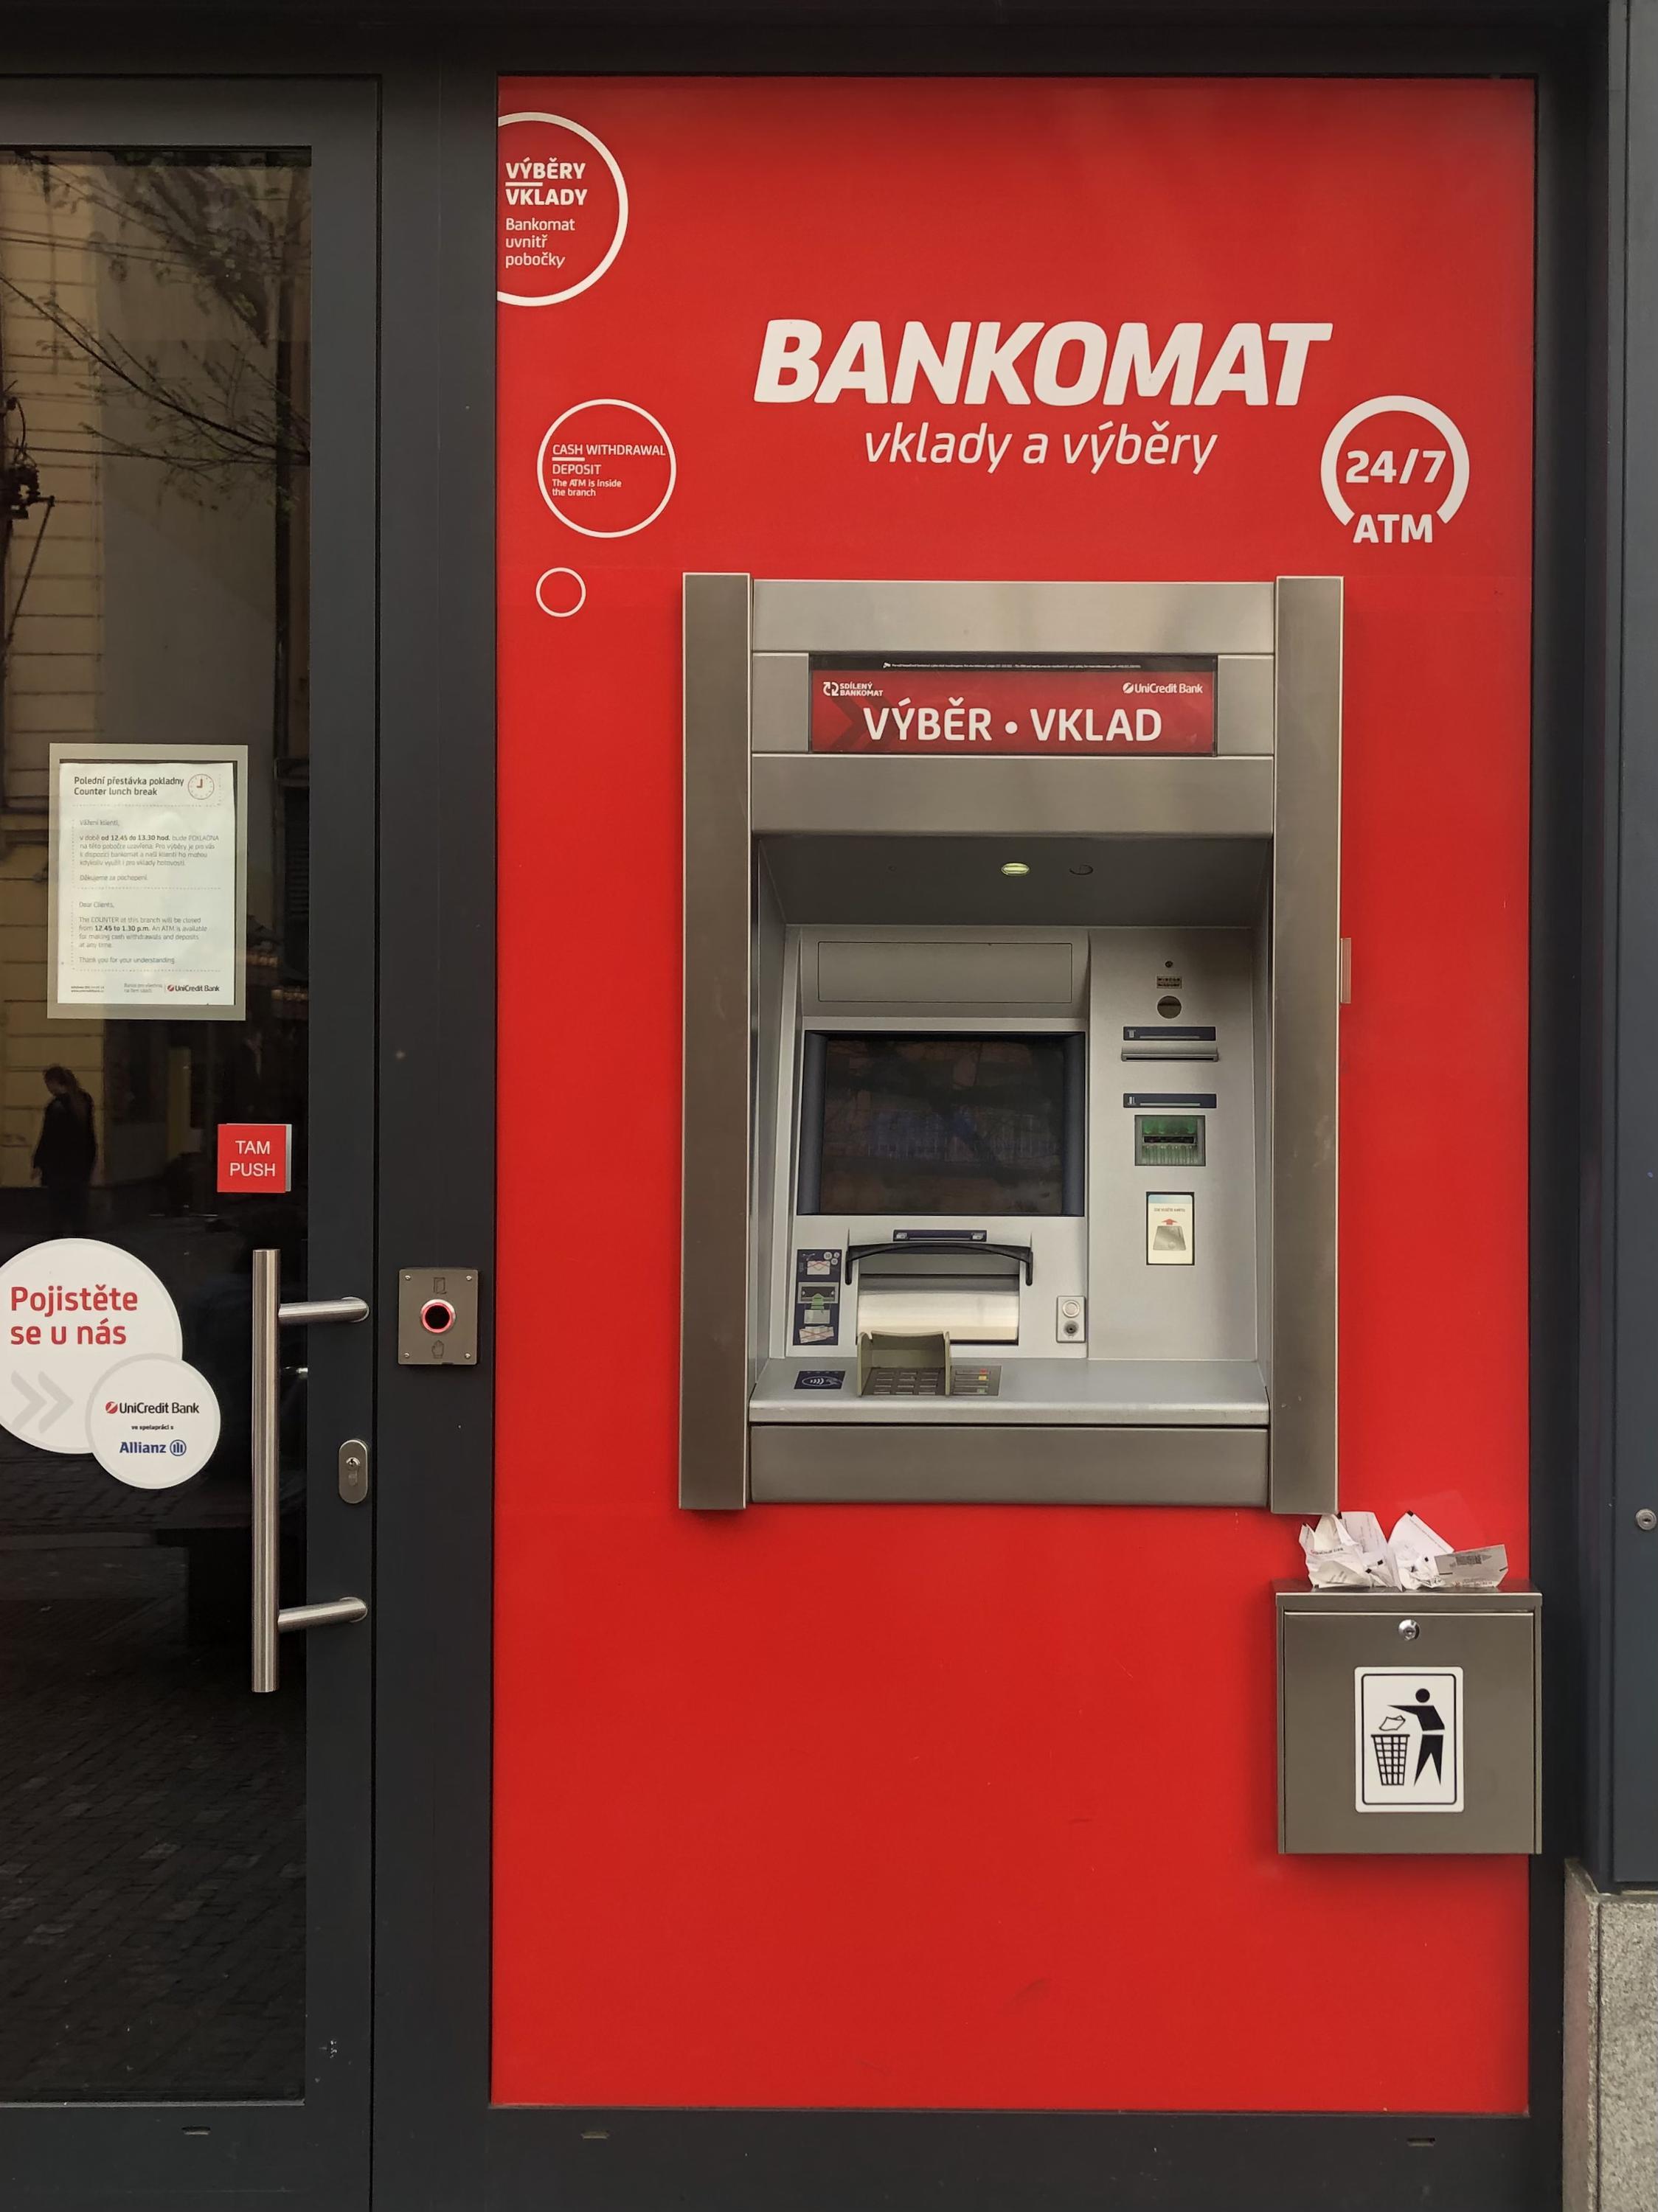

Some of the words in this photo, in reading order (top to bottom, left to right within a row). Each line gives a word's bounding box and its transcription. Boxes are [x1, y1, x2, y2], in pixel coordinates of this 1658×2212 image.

[505, 156, 586, 180] VÝBĚRY
[505, 188, 588, 206] VKLADY
[505, 218, 575, 231] Bankomat
[505, 234, 548, 248] uvnitř
[505, 251, 566, 268] pobočky
[752, 318, 1333, 407] BANKOMAT
[552, 444, 583, 455] CASH
[586, 444, 666, 456] WITHDRAWAL
[864, 421, 1013, 475] vklady
[1023, 432, 1047, 465] a
[1064, 420, 1218, 475] výběry
[552, 464, 602, 475] DEPOSIT
[1345, 448, 1446, 484] 24/7
[552, 479, 567, 487] The
[569, 479, 586, 487] ATM
[588, 479, 595, 487] is
[597, 479, 622, 487] inside
[552, 488, 566, 496] the
[567, 488, 596, 496] branch
[1353, 513, 1434, 543] ATM
[1134, 683, 1177, 693] UniCredit
[1179, 683, 1203, 693] Bank
[863, 697, 993, 741] VÝBĚR
[1030, 709, 1162, 742] VKLAD
[74, 776, 105, 785] Polední
[107, 776, 147, 786] přestávka
[149, 777, 184, 786] pokladny
[74, 787, 106, 796] Counter
[109, 787, 131, 796] lunch
[134, 787, 158, 796] break
[235, 1141, 271, 1155] TAM
[229, 1163, 276, 1178] PUSH
[10, 1285, 139, 1317] Pojistěte
[10, 1325, 41, 1345] se
[51, 1326, 67, 1345] u
[77, 1318, 127, 1346] nás
[119, 1402, 169, 1413] UniCredit
[171, 1402, 200, 1413] Bank
[119, 1442, 167, 1453] Allianz
